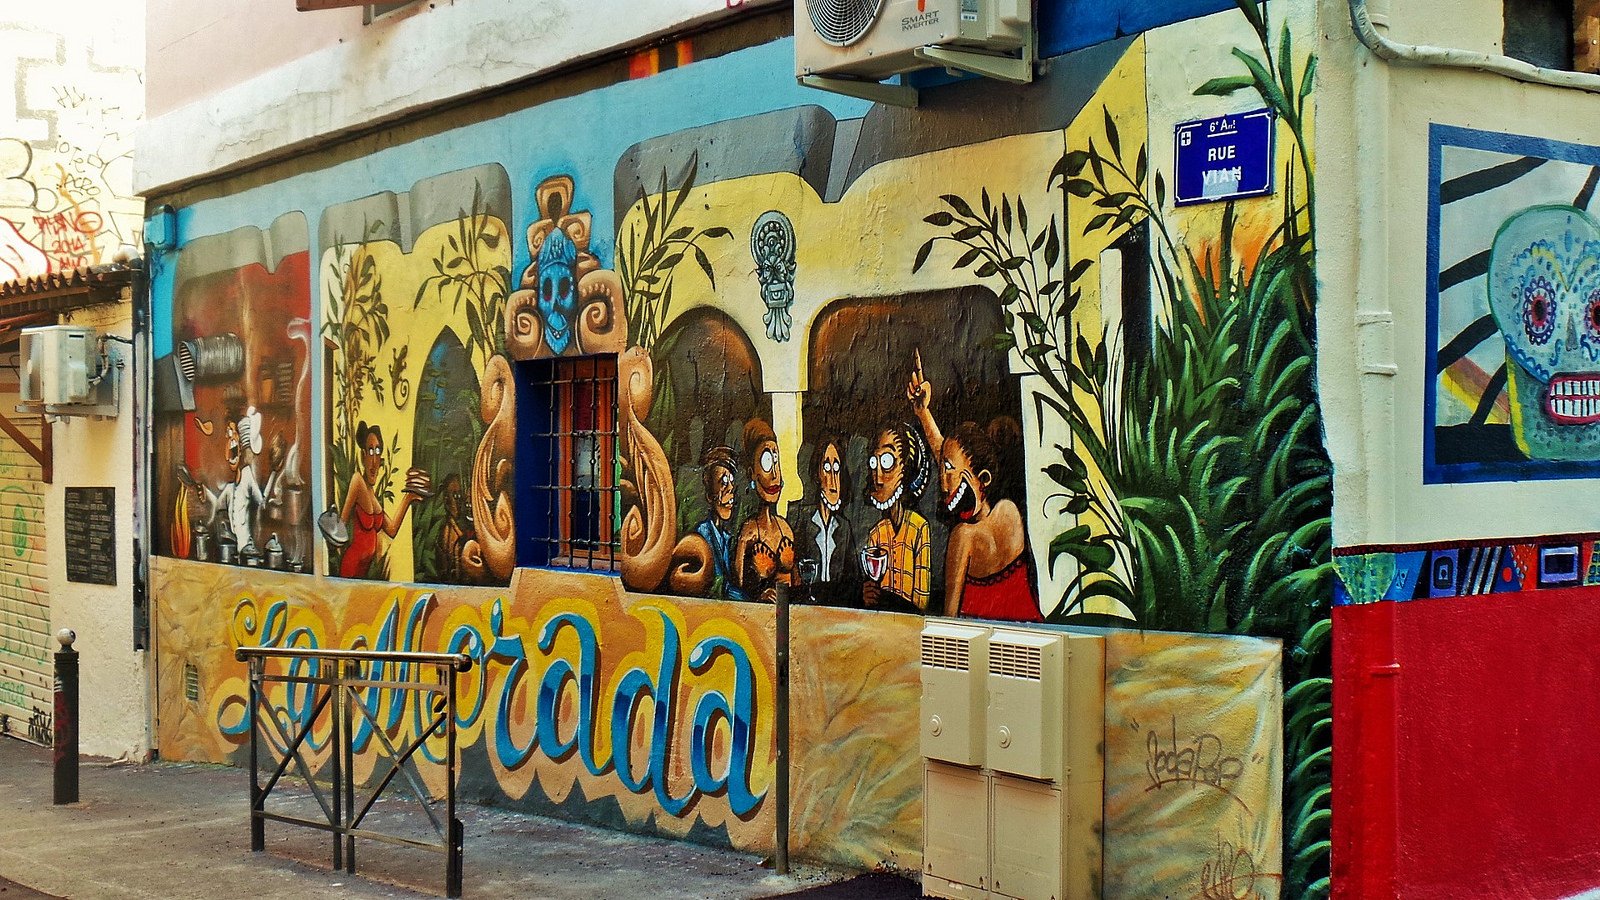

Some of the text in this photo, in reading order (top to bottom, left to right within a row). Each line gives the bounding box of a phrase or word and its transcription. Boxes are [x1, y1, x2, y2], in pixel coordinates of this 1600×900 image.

[901, 10, 939, 26] SMART
[901, 18, 939, 31] INVERTER
[1207, 145, 1236, 162] RUE
